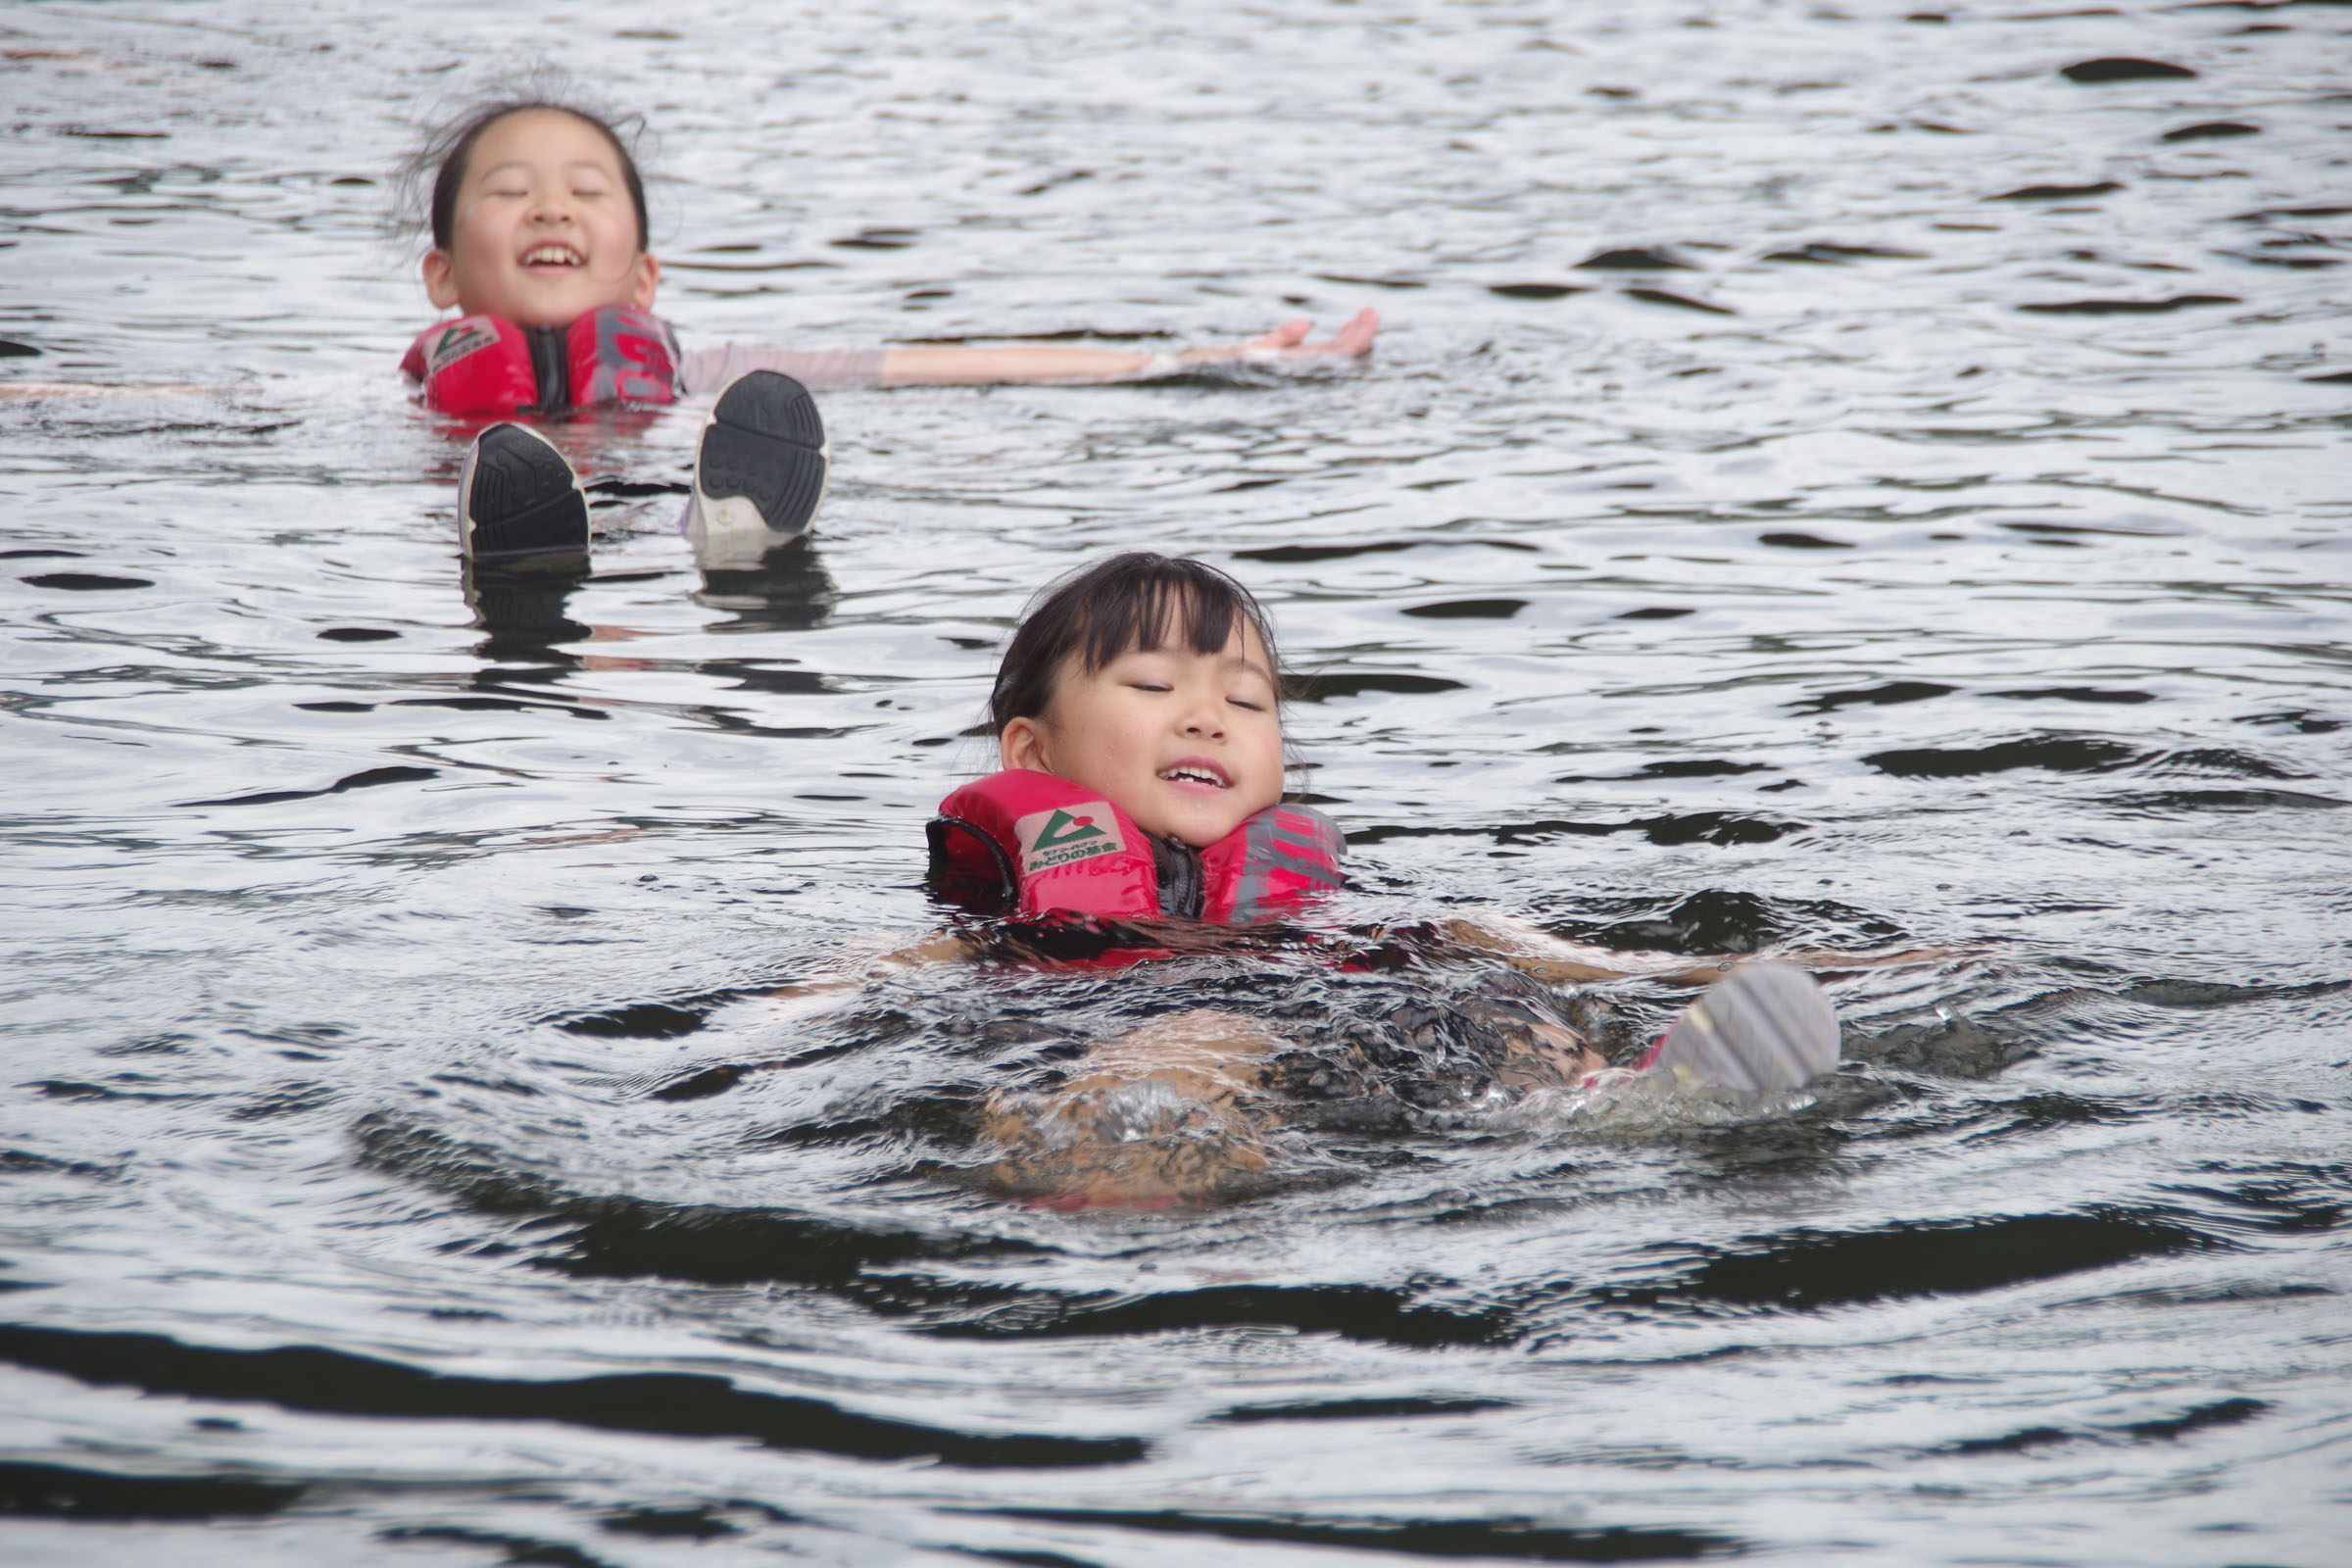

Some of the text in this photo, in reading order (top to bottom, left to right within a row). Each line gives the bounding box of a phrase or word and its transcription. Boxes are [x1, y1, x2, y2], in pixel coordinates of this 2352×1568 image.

[1029, 842, 1117, 871] みどりの基金
